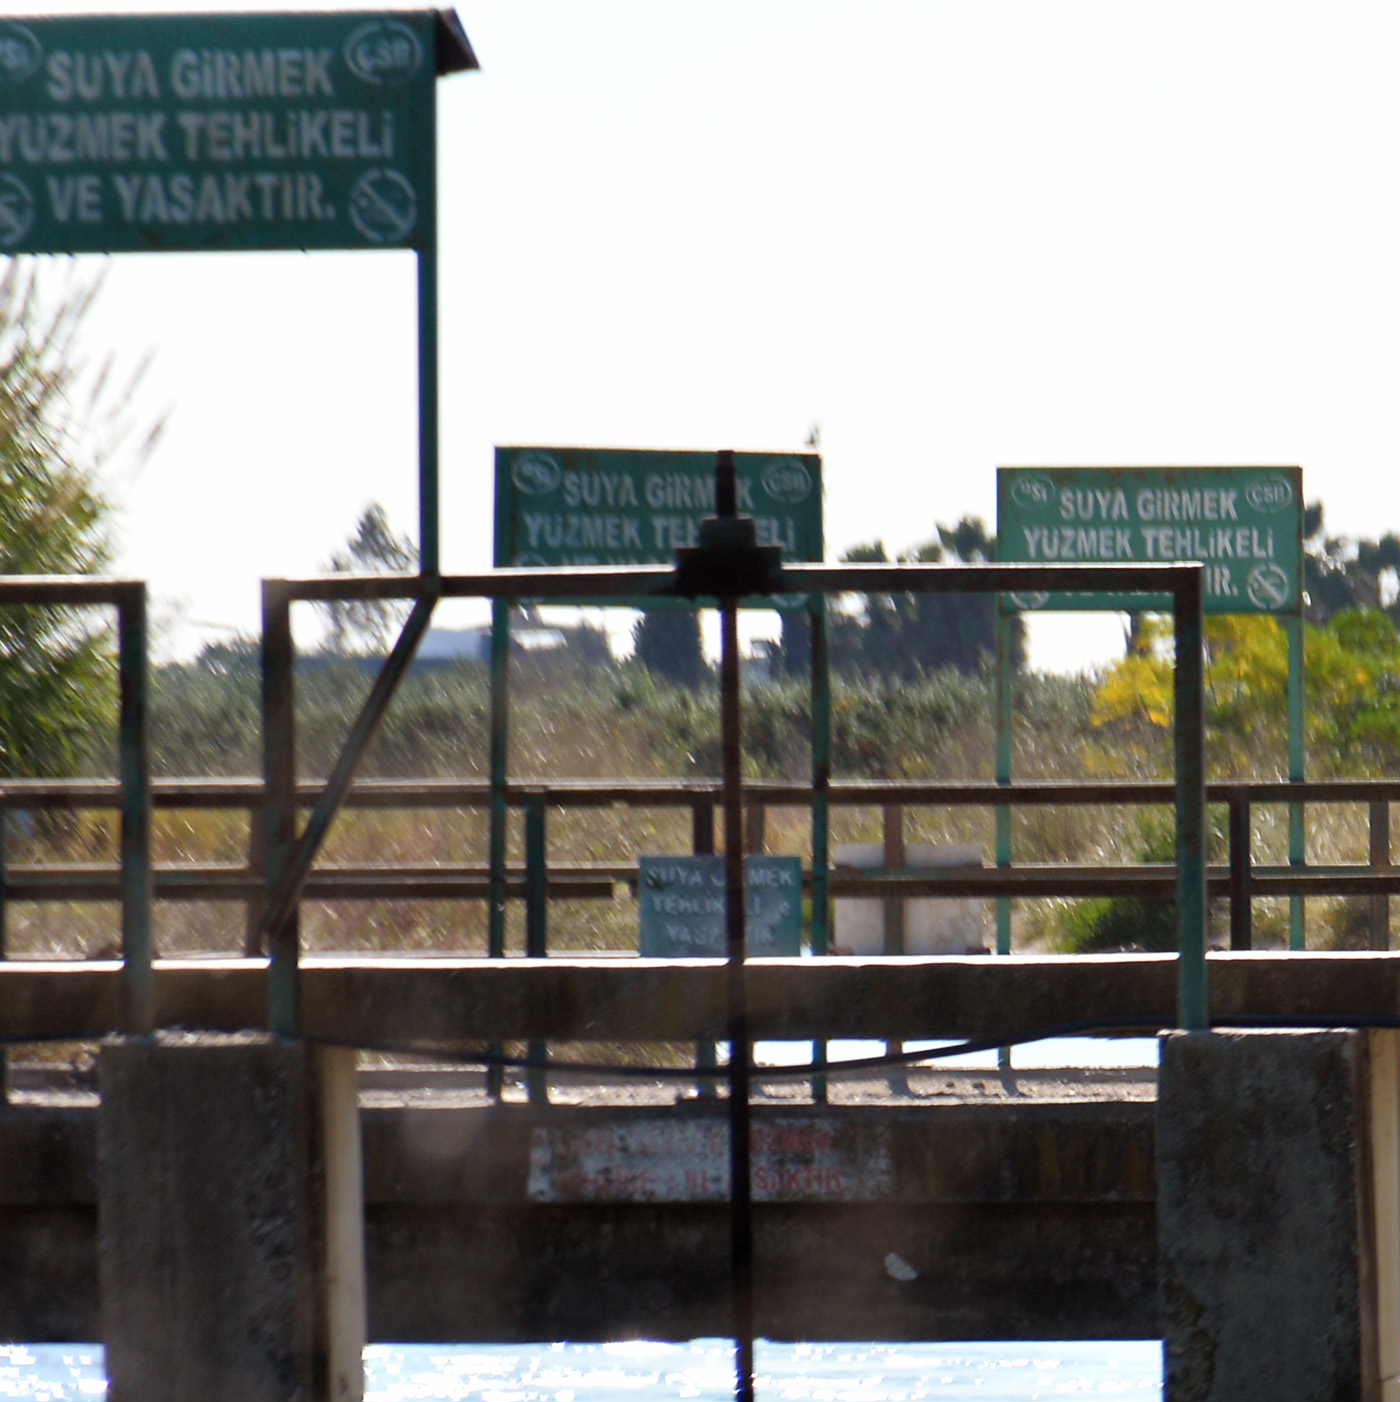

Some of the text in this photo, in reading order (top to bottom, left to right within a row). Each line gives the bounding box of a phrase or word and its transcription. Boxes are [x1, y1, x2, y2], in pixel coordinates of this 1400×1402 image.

[47, 49, 160, 100] SUYA
[47, 173, 101, 224] VE
[563, 472, 638, 507] SUYA
[646, 474, 755, 509] GİRMK
[1059, 487, 1129, 521] SUYA
